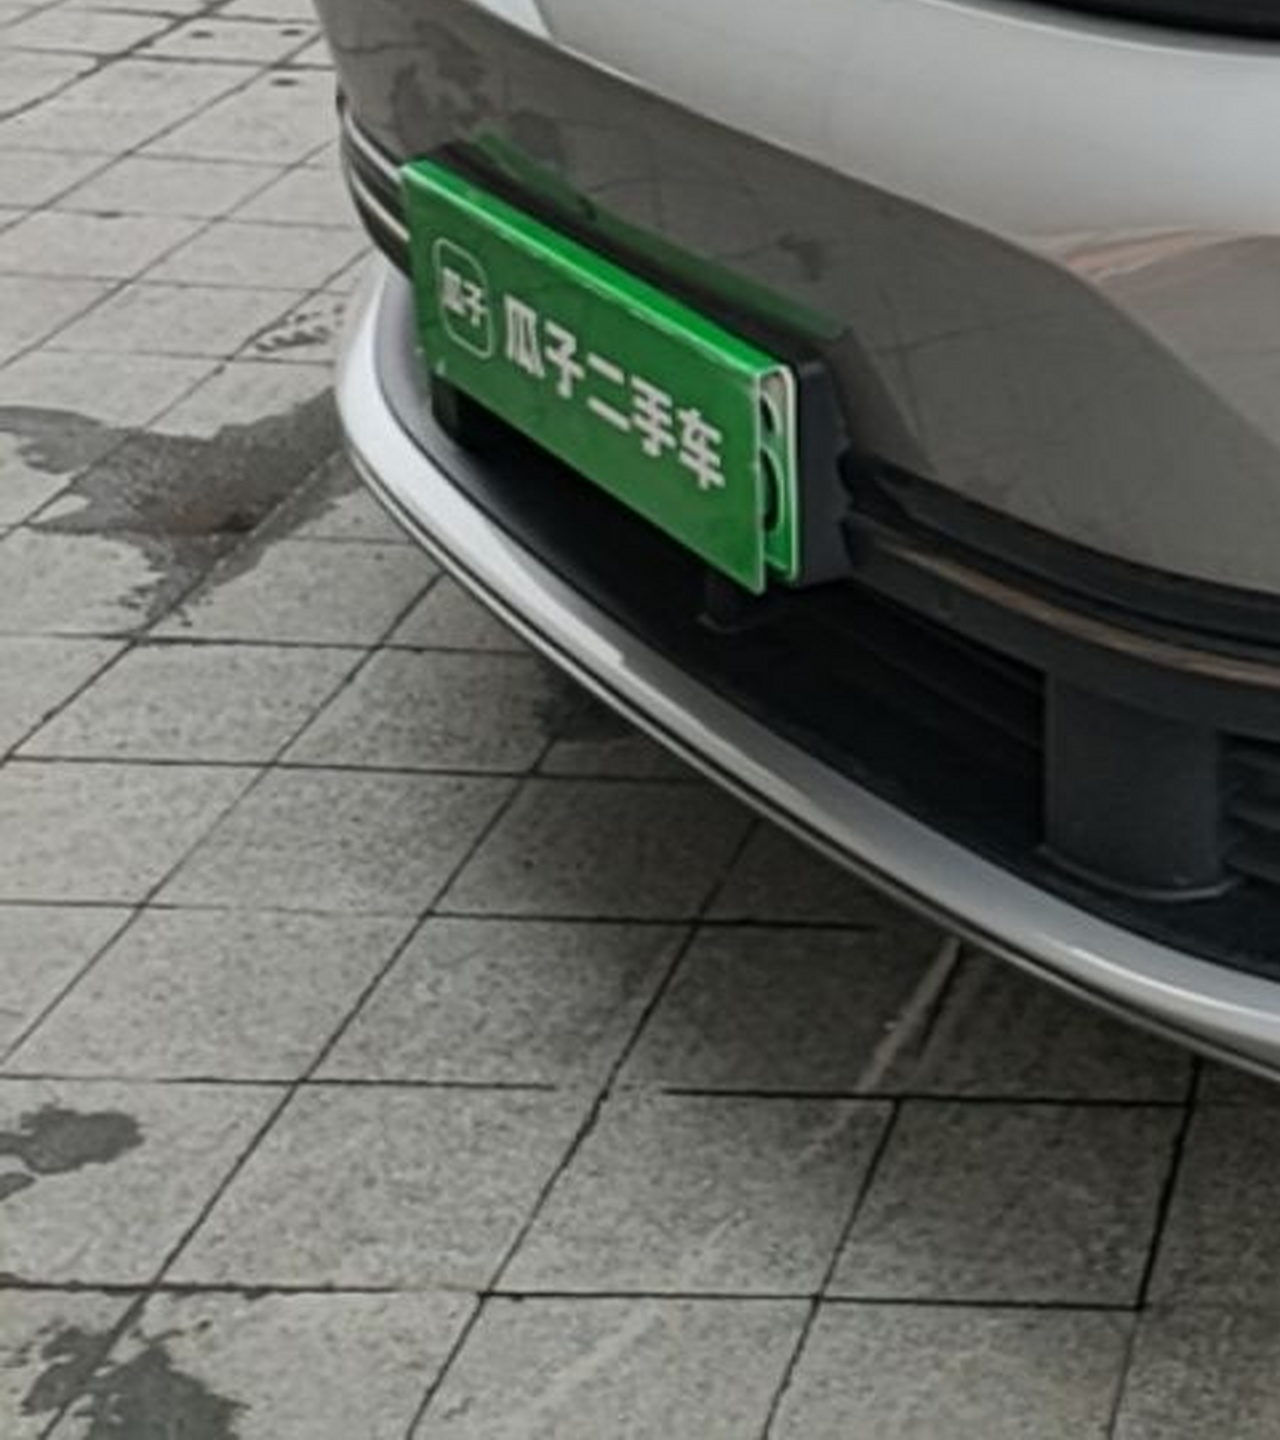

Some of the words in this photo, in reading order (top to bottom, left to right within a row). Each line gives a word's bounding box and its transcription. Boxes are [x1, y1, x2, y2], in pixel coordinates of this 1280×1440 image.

[502, 293, 726, 491] 瓜子二手车
